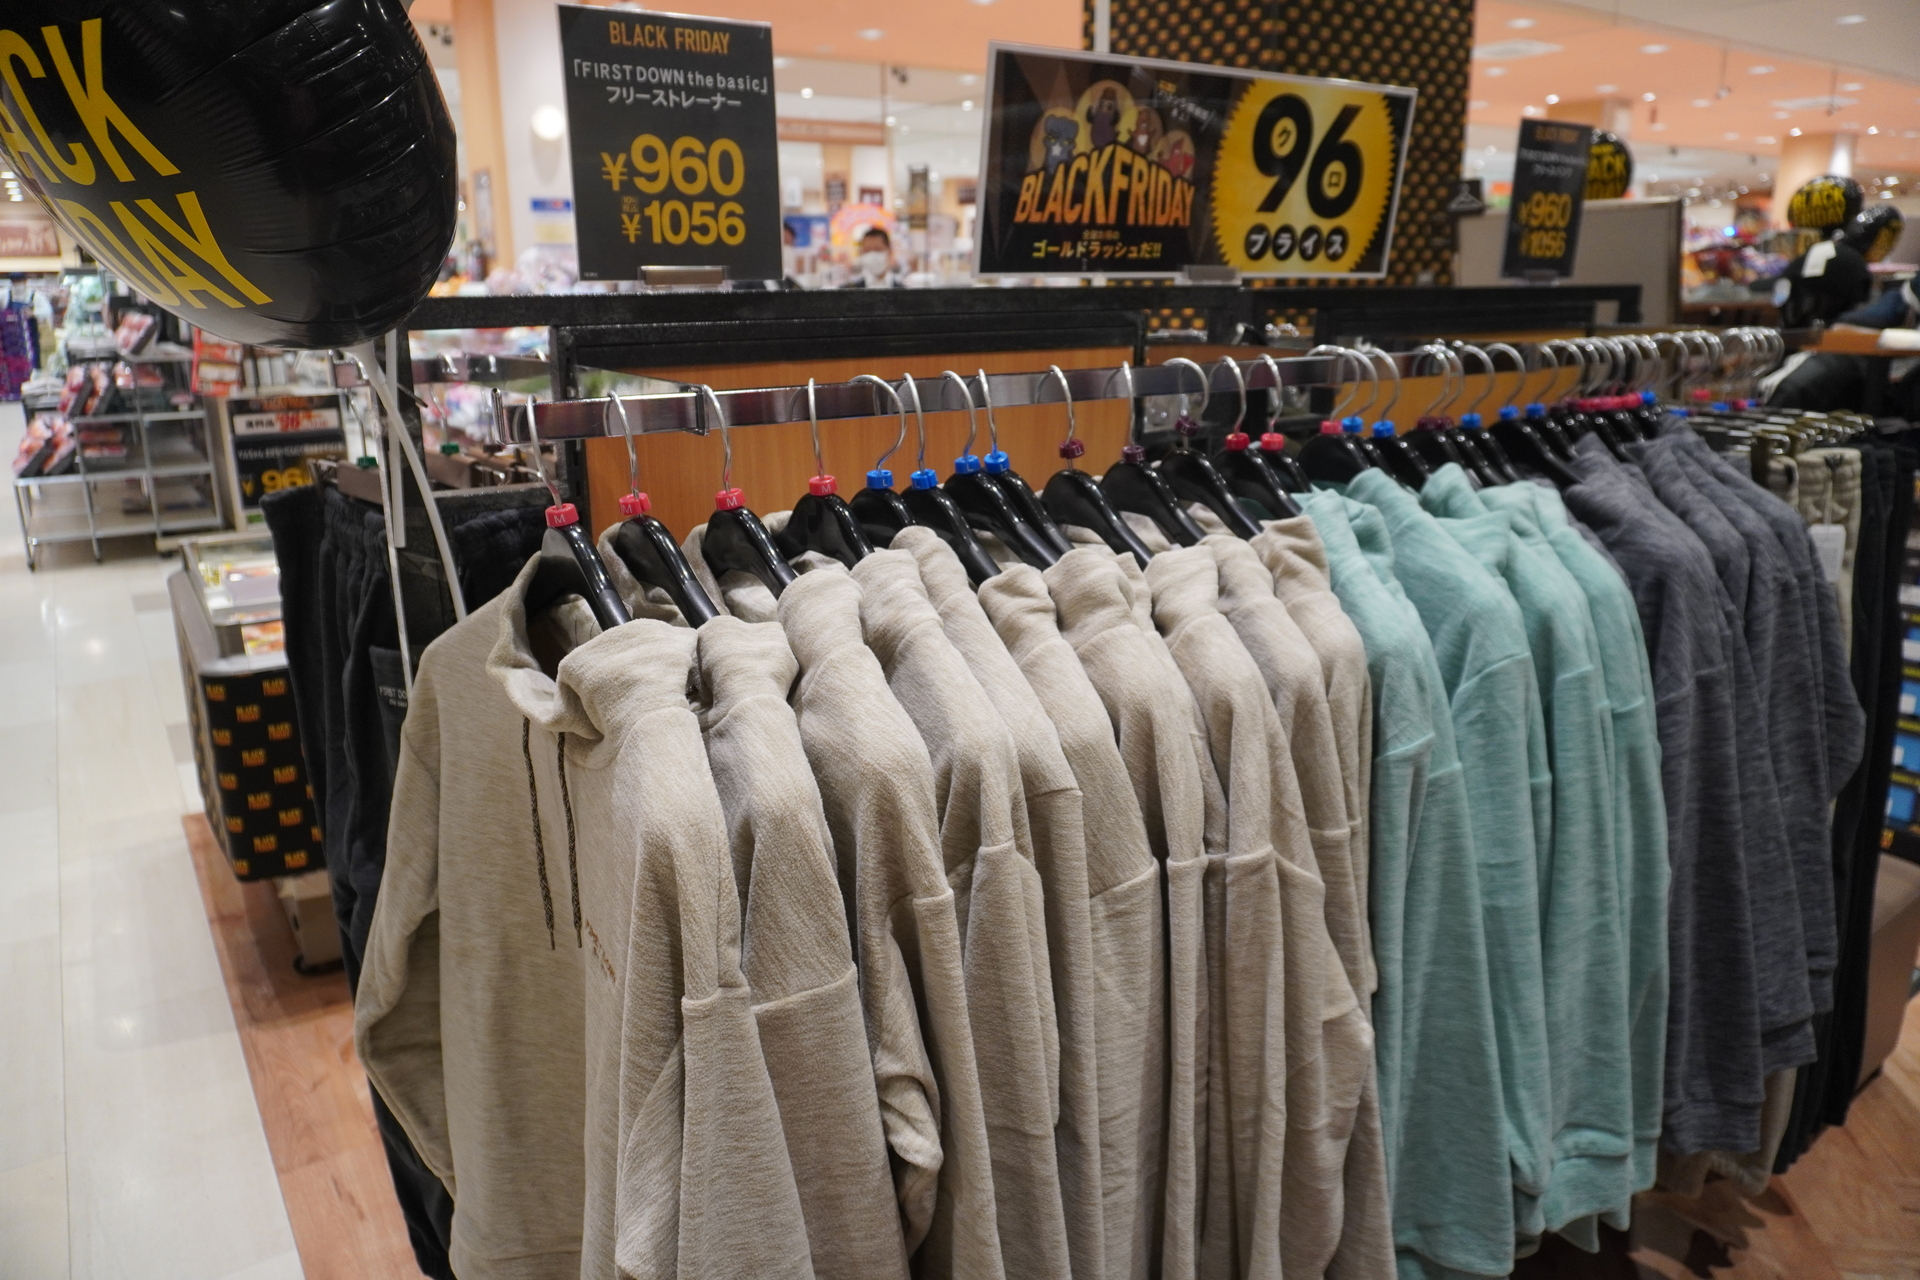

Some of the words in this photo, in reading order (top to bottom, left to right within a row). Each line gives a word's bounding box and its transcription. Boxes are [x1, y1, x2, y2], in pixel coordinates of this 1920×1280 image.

[609, 21, 668, 49] BLACK
[675, 27, 730, 54] FRIDAY
[636, 67, 684, 86] DOWN
[687, 70, 714, 87] the
[606, 86, 741, 110] フリーストレーナー
[1252, 93, 1364, 218] 96
[601, 133, 745, 196] ¥960
[621, 200, 746, 245] ¥1056
[1248, 230, 1344, 257] プライス
[967, 463, 974, 472] L
[1001, 464, 1007, 472] L
[821, 484, 831, 494] M
[883, 479, 889, 487] L
[622, 504, 633, 514] M
[726, 496, 738, 507] M
[553, 514, 566, 525] M
